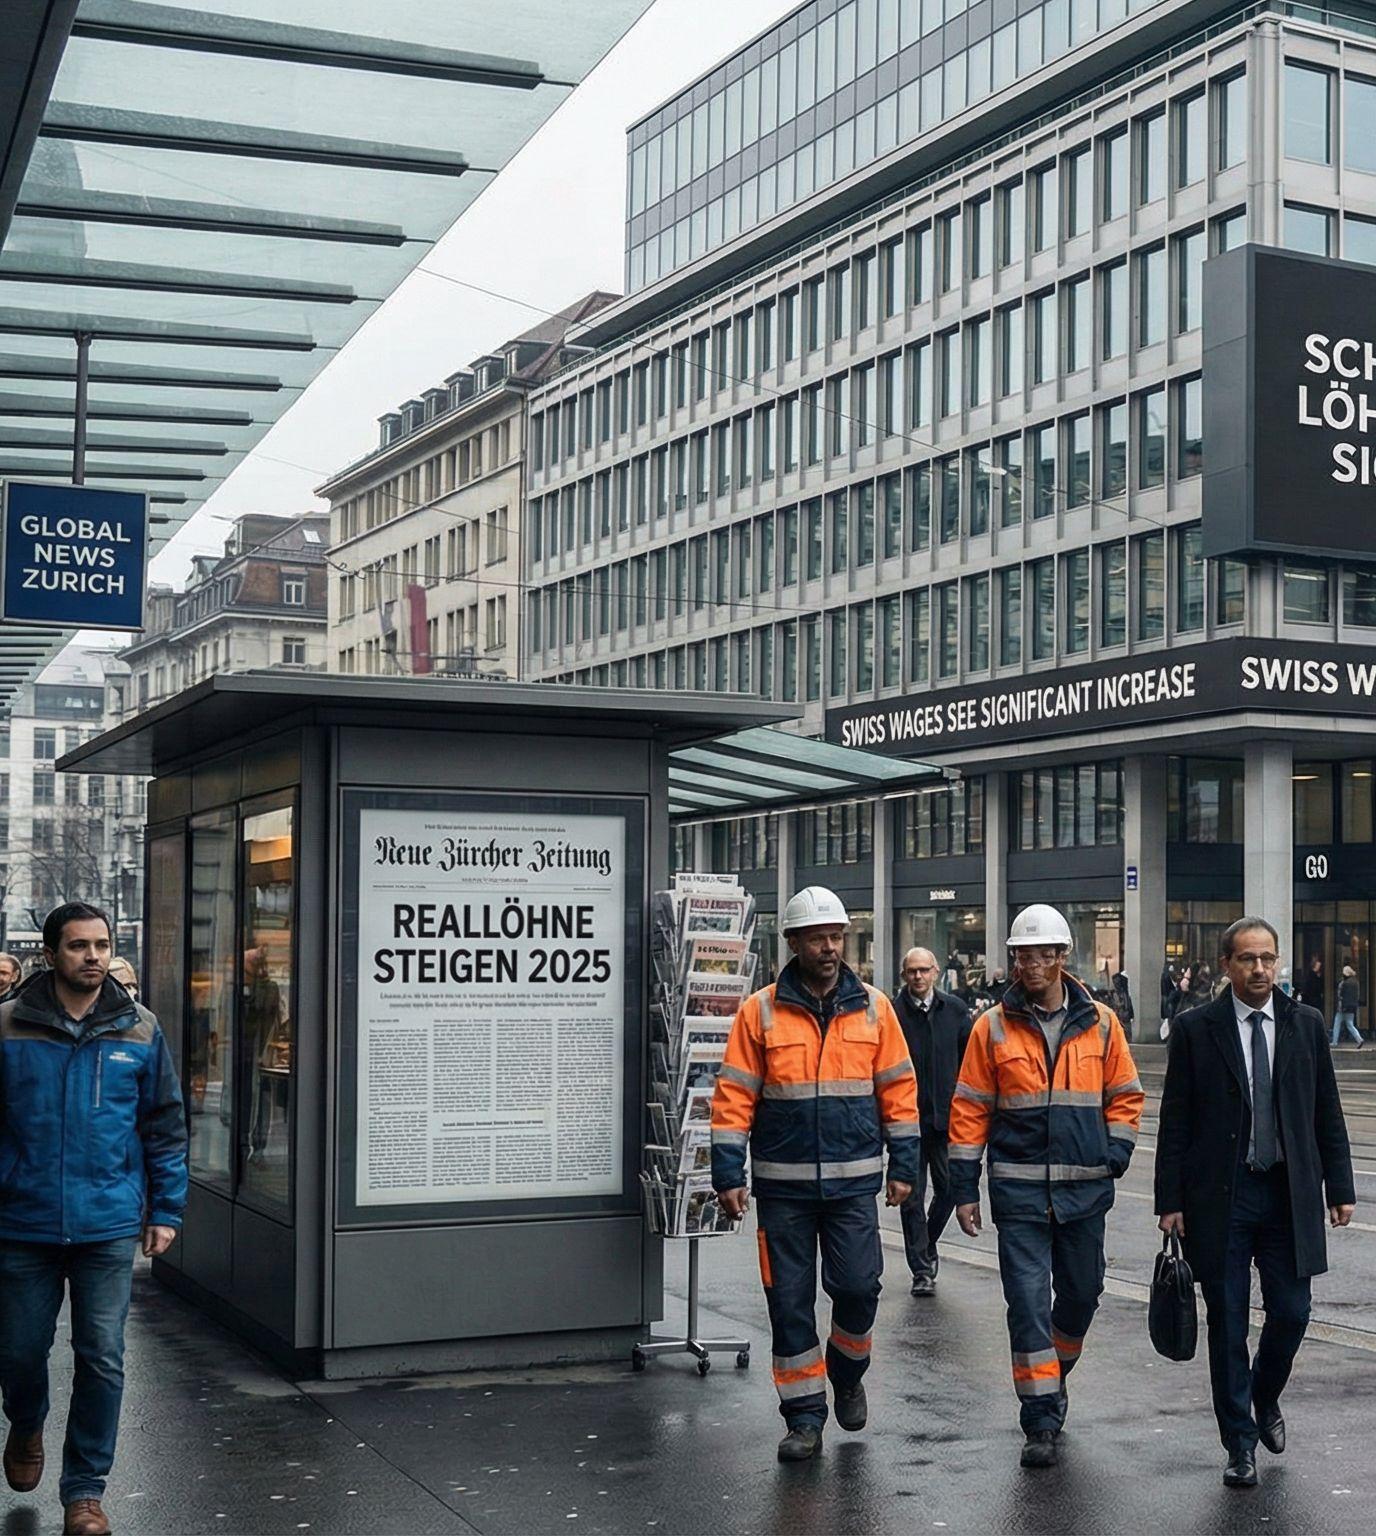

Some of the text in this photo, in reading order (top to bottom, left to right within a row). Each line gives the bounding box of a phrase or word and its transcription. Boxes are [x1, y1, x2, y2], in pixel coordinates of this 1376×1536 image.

[21, 516, 130, 542] GLOBAL
[35, 543, 114, 567] NEWS
[23, 569, 124, 594] ZURICH
[1242, 657, 1338, 693] SWISS
[841, 663, 1195, 748] SWISS WAGES SEE SIGNIFICANT INCREASE
[375, 837, 611, 876] Neue Zürcher Zeitung
[1306, 855, 1327, 878] GO
[394, 897, 593, 939] REALLÖHNE
[374, 949, 610, 983] STEIGEN 2025
